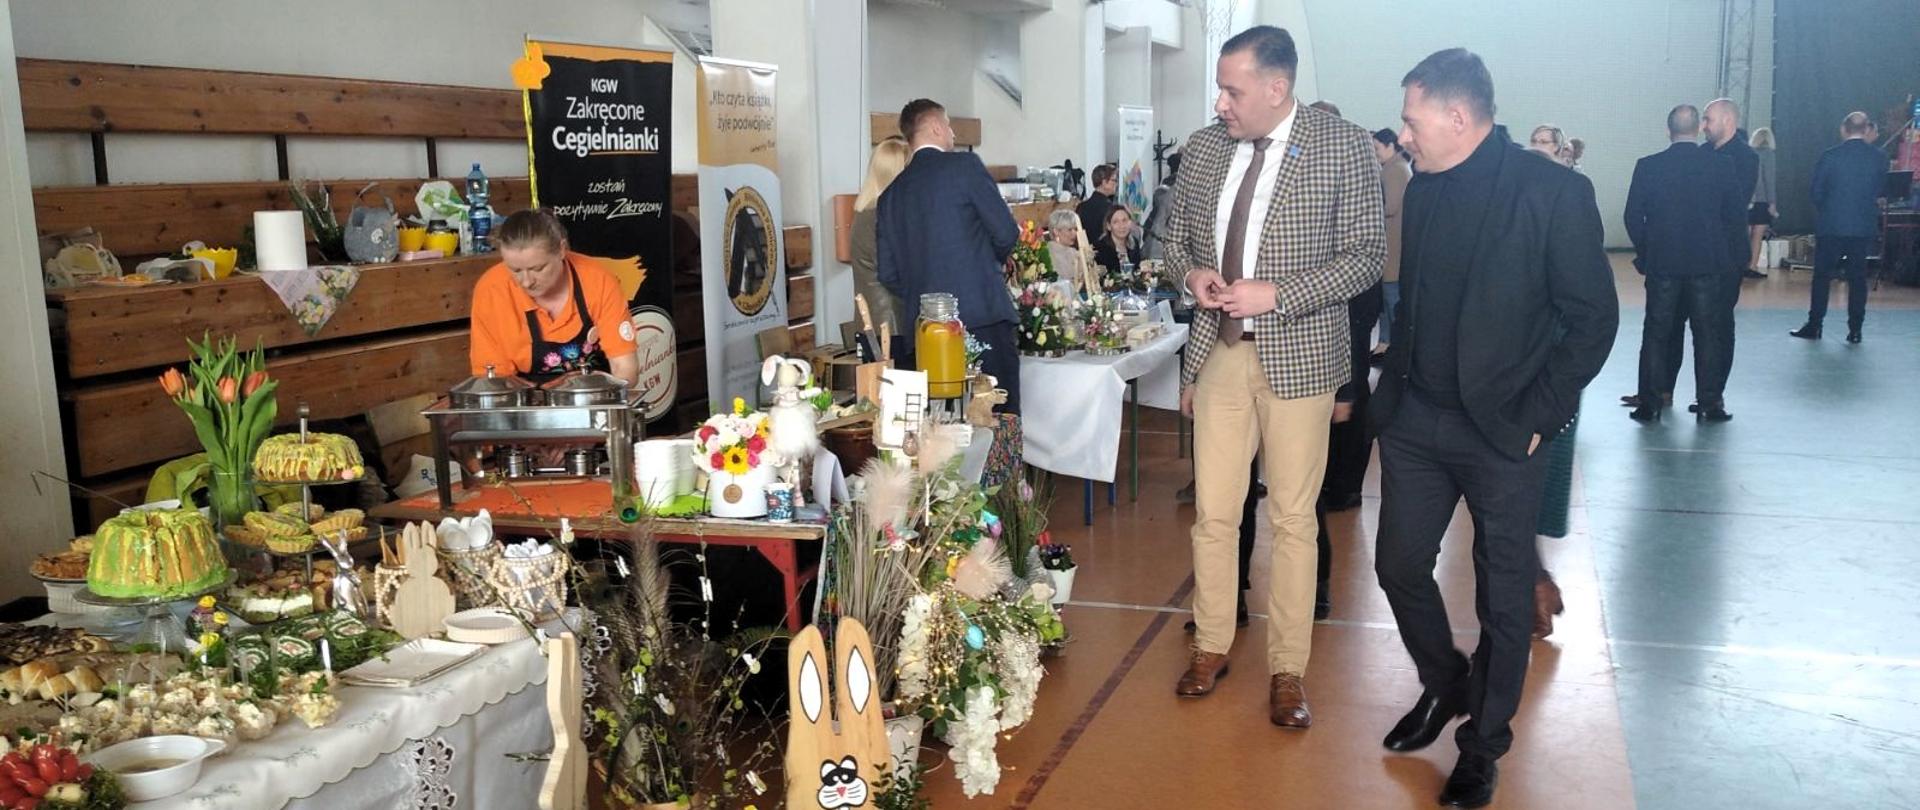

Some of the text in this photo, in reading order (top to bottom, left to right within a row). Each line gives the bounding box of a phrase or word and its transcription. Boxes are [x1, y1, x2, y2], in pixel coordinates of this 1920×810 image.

[591, 78, 618, 93] KGW
[726, 92, 745, 108] czyta
[566, 95, 645, 125] Zakręcone
[552, 125, 659, 157] Cegielnianki
[587, 178, 626, 193] zostań
[553, 200, 609, 221] pozytywnie
